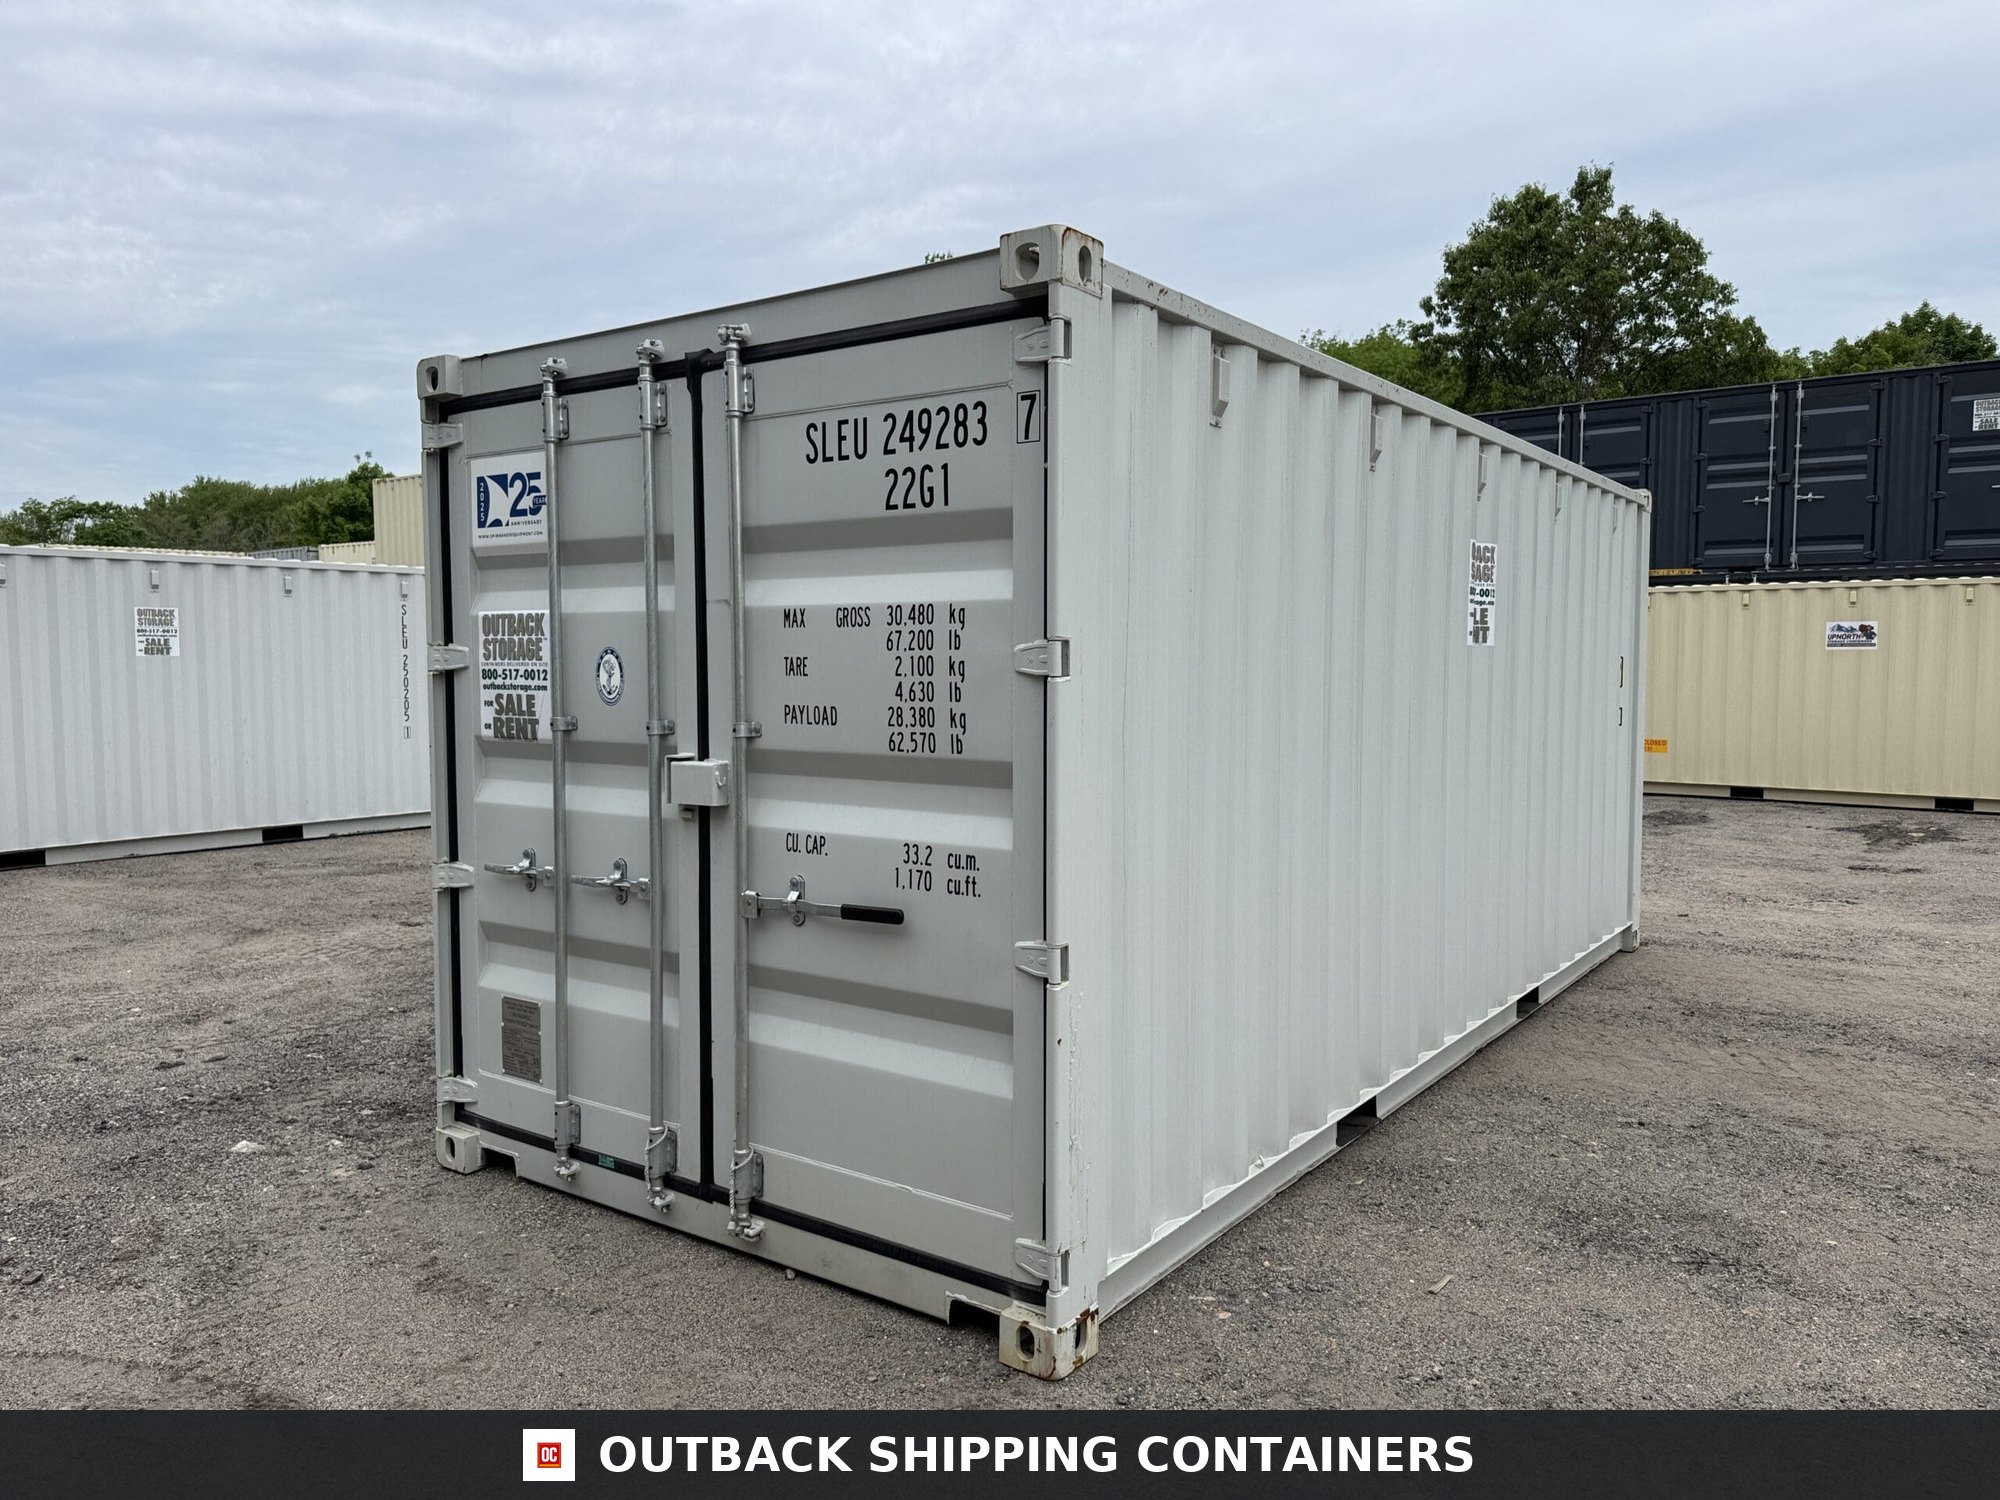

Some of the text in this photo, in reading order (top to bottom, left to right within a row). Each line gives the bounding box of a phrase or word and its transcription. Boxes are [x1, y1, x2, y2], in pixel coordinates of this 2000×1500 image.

[805, 393, 1038, 464] SLEU 249283 7
[509, 472, 541, 517] 25
[884, 462, 950, 511] 22G1
[137, 608, 175, 618] OUTBACK
[138, 617, 174, 626] STORAGE
[482, 612, 545, 637] OUTBACK
[783, 603, 965, 630] MAX GROSS 30,480 kg
[144, 646, 172, 655] RENT
[145, 638, 170, 647] SALE
[483, 637, 543, 661] STORAGE
[886, 630, 961, 652] 67,200 lb
[481, 668, 548, 681] 800-517-0012
[784, 656, 965, 683] TARE 2,100 kg
[483, 681, 548, 692] outbackstorage.com
[895, 681, 961, 703] 4,630 lb
[495, 693, 536, 716] SALE
[493, 717, 539, 741] RENT
[784, 705, 966, 735] PAYLOAD 28,380 kg
[888, 732, 963, 755] 62,570 lb
[785, 832, 980, 871] CU. CAP. 33.2 cu.m.
[895, 868, 981, 898] 1,170 cu.ft.
